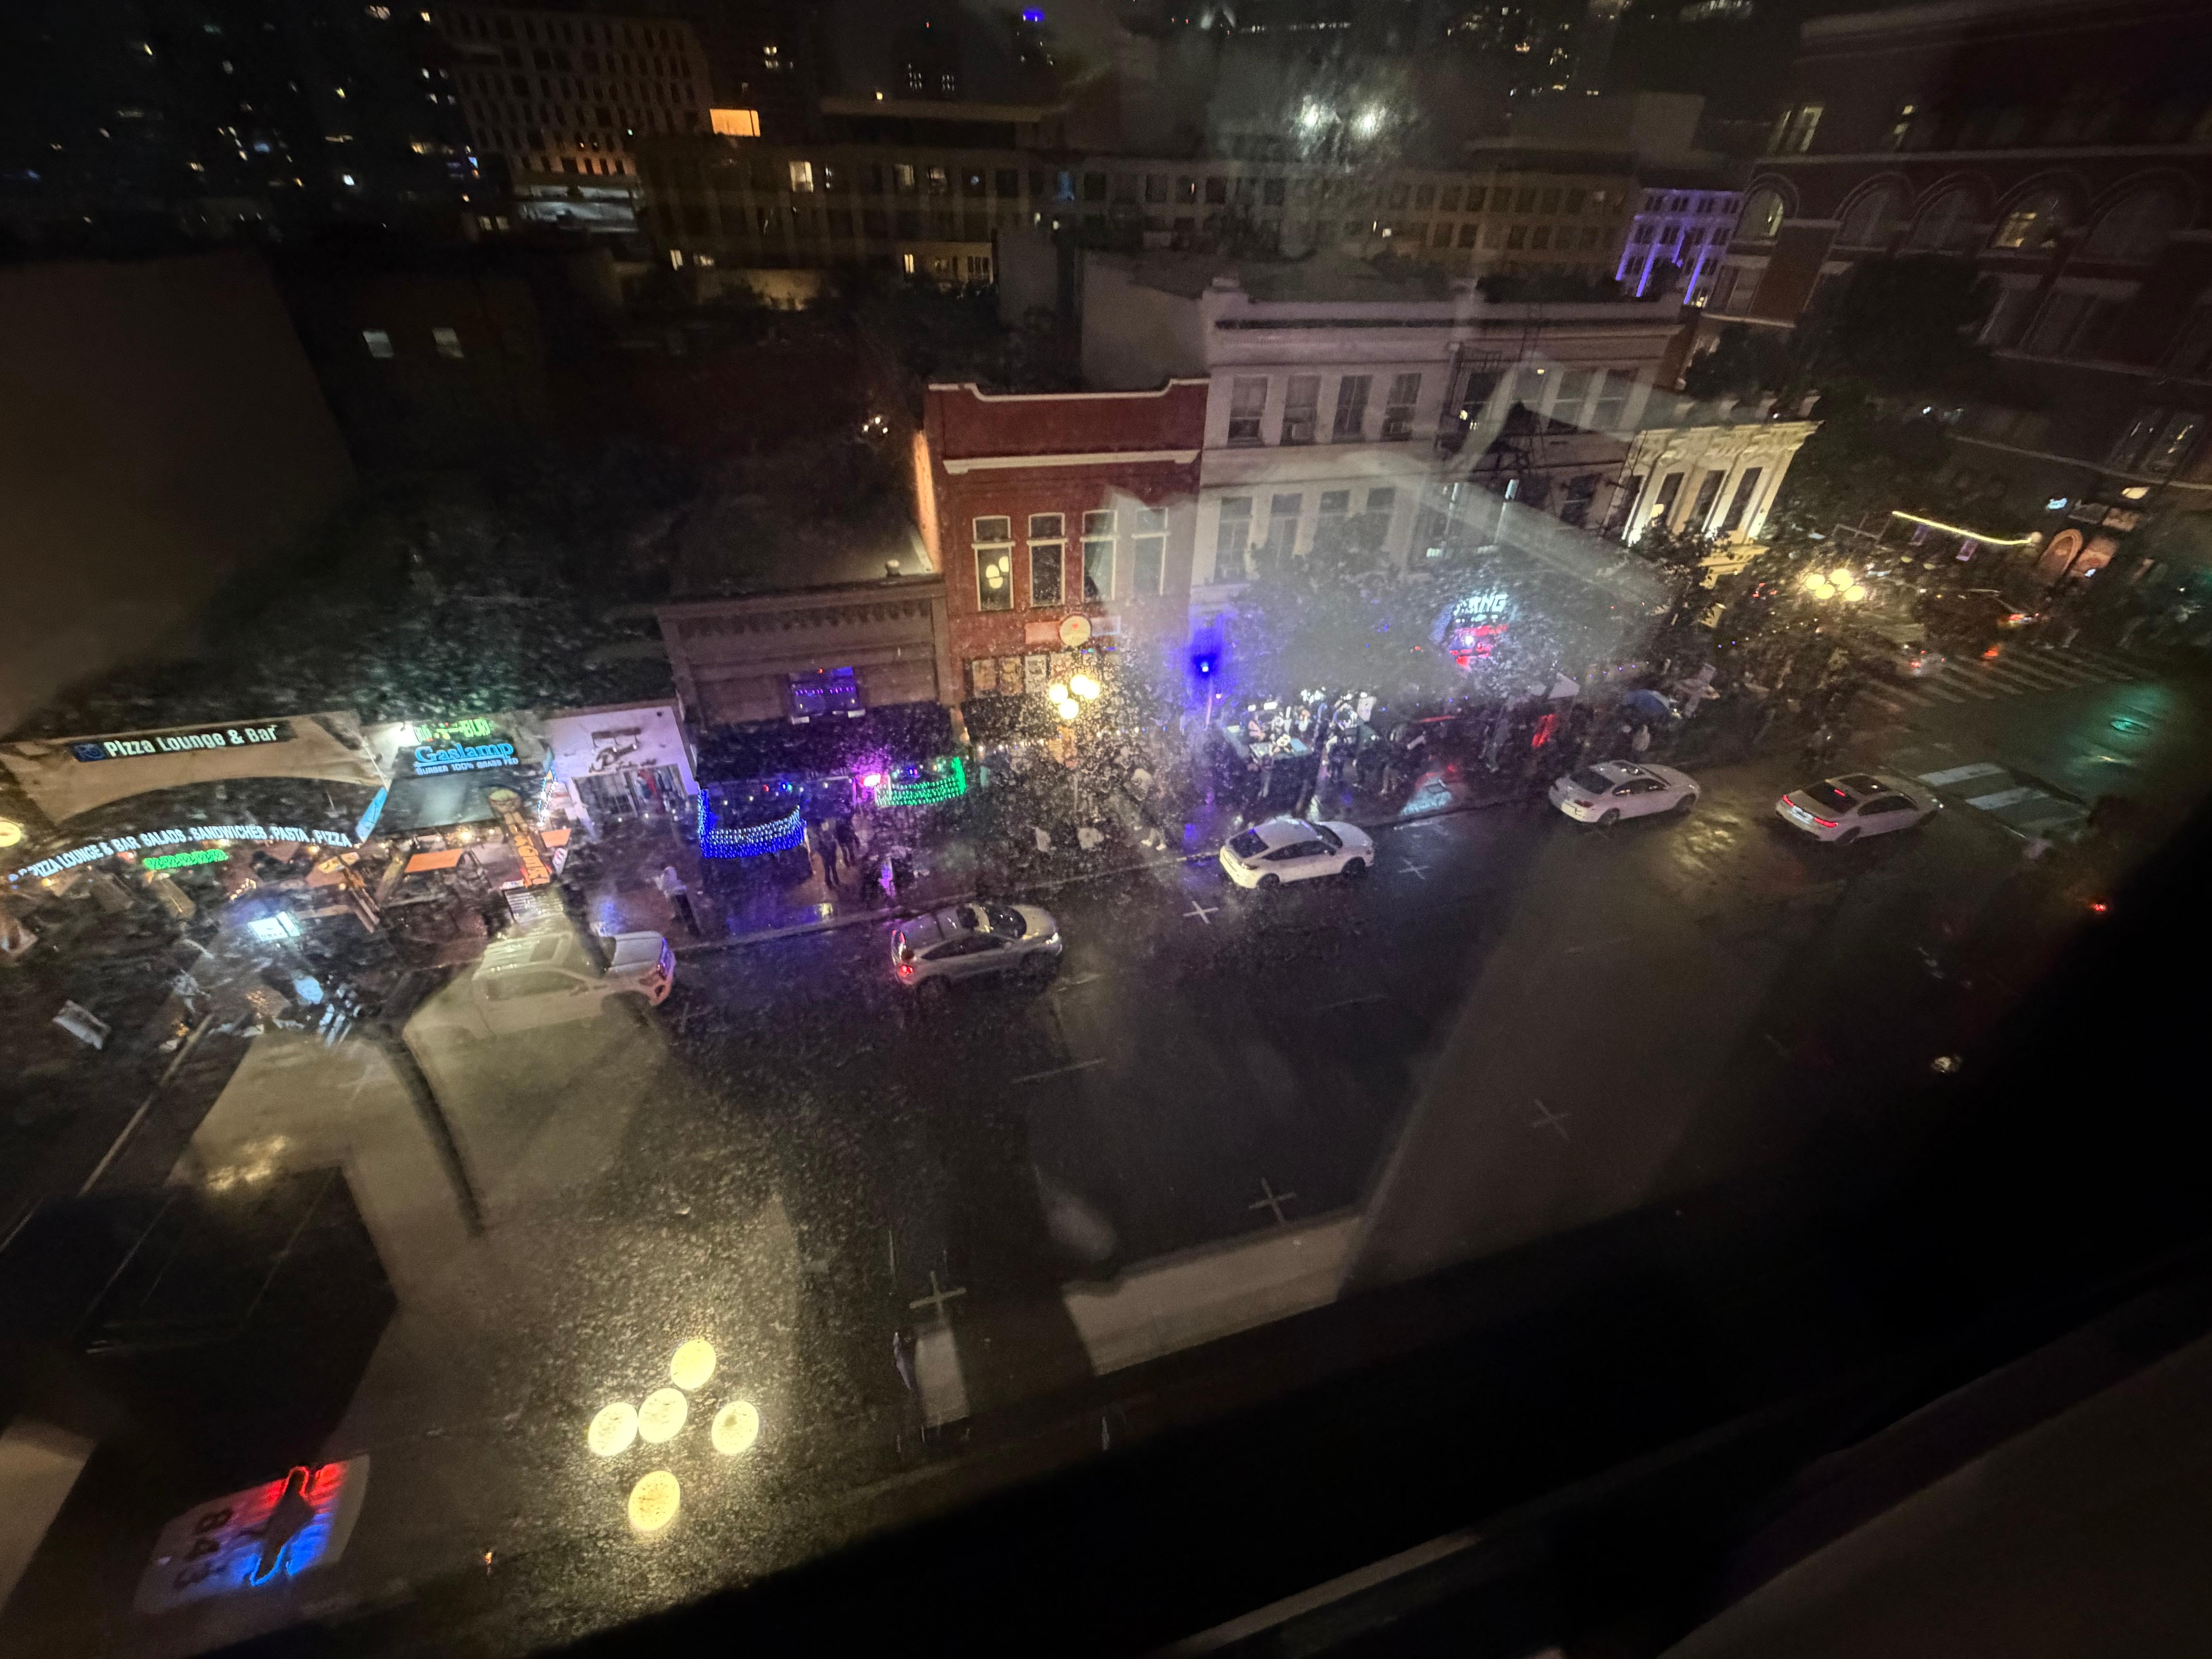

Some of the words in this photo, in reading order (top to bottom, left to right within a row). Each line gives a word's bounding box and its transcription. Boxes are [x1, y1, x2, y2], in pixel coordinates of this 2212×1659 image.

[104, 740, 156, 757] Pizza
[156, 733, 226, 751] Lounge
[227, 730, 245, 745] &
[245, 728, 277, 742] Bar
[415, 742, 514, 762] Gaslamp
[56, 844, 104, 868] LOUNGE
[111, 836, 141, 853] BAR
[138, 829, 187, 847] SALADS
[189, 825, 267, 840] SANDWICHES
[269, 826, 310, 842] PASTA
[312, 829, 353, 848] PIZZA
